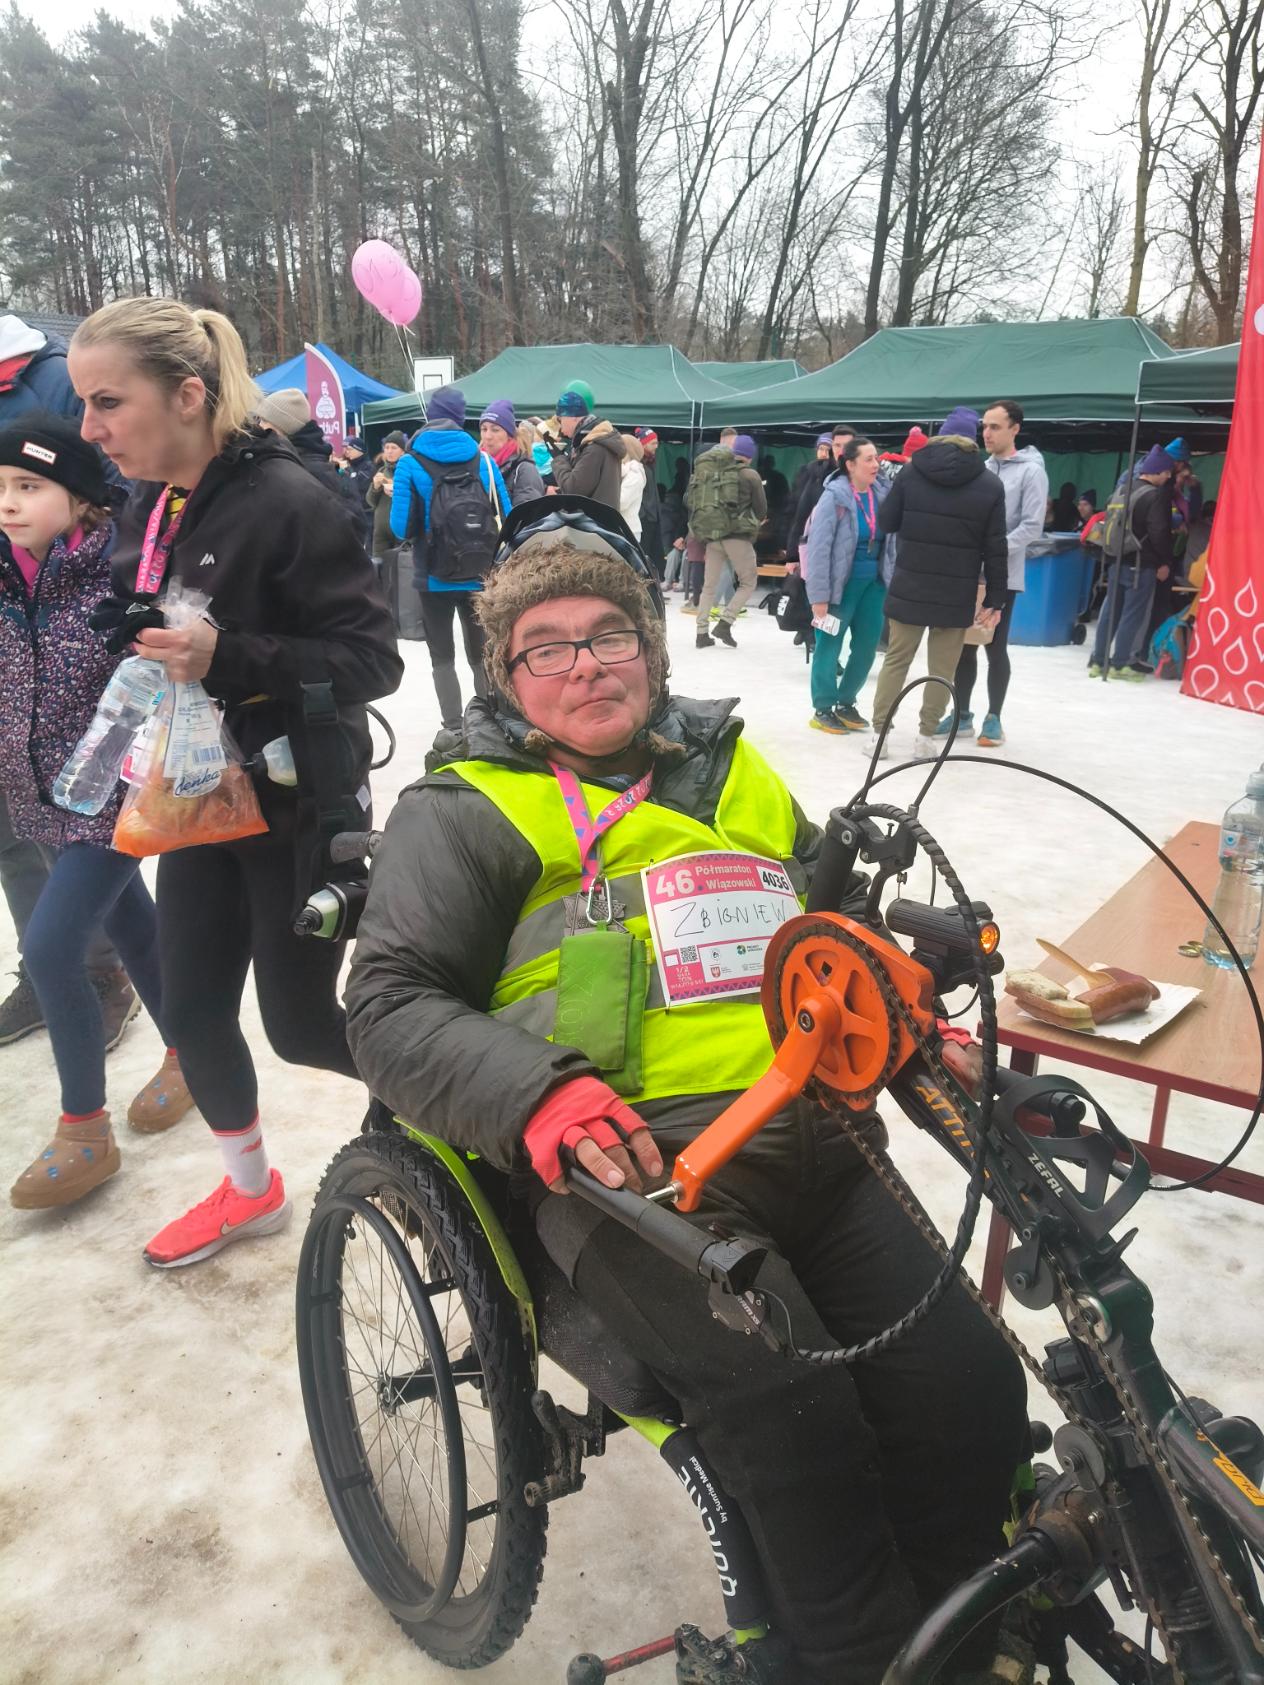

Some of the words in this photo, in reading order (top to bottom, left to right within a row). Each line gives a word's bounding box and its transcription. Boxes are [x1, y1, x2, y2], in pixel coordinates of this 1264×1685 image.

[695, 864, 752, 876] Półmaraton
[670, 899, 786, 938] ZBIGNIEW
[689, 1455, 709, 1484] Medical
[706, 1483, 723, 1512] Sunrise
[719, 1511, 728, 1524] by
